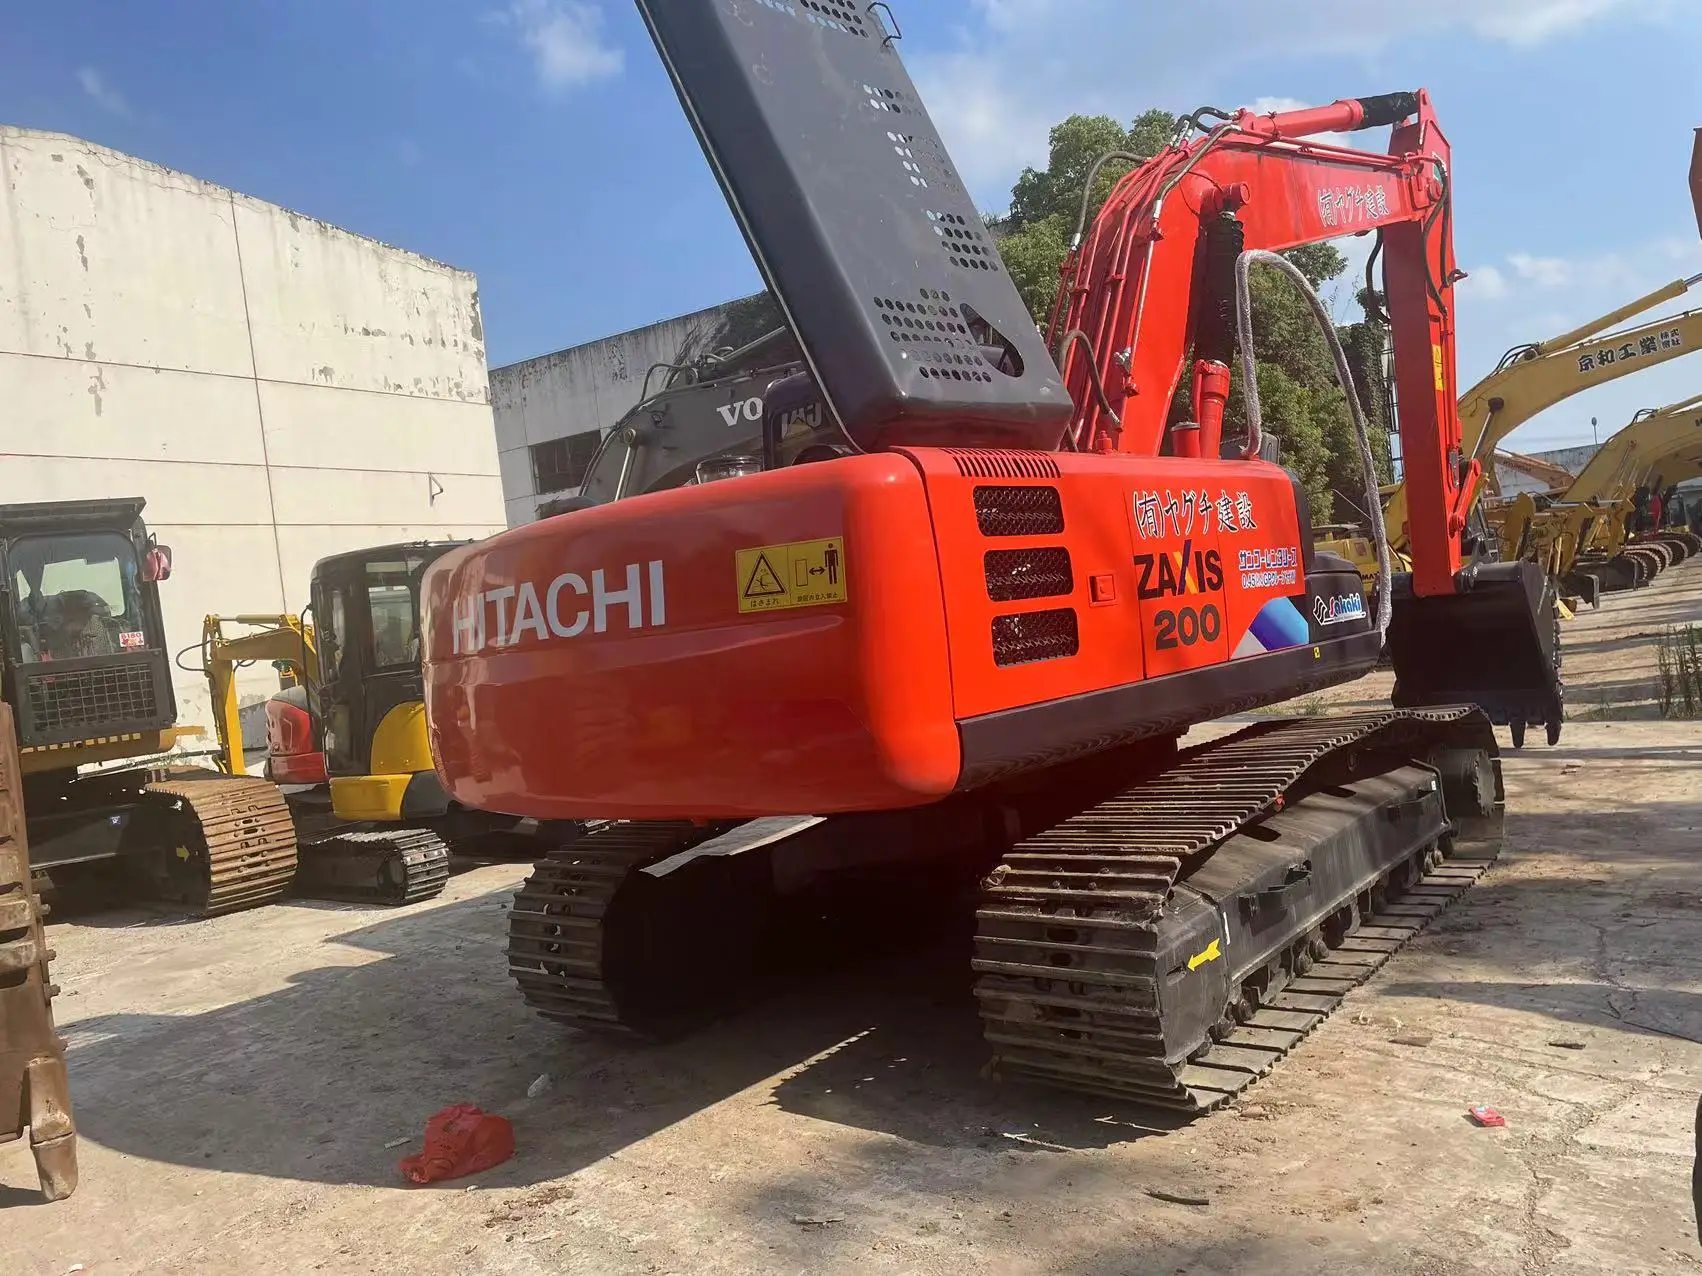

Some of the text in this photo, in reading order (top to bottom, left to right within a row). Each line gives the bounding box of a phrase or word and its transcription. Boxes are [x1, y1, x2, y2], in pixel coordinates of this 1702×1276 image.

[1133, 489, 1257, 539] (有)ヤグチ建設
[1133, 539, 1224, 601] ZAXIS
[452, 559, 666, 655] HITACHI
[1153, 603, 1221, 650] 200
[1329, 592, 1363, 618] Sakaki
